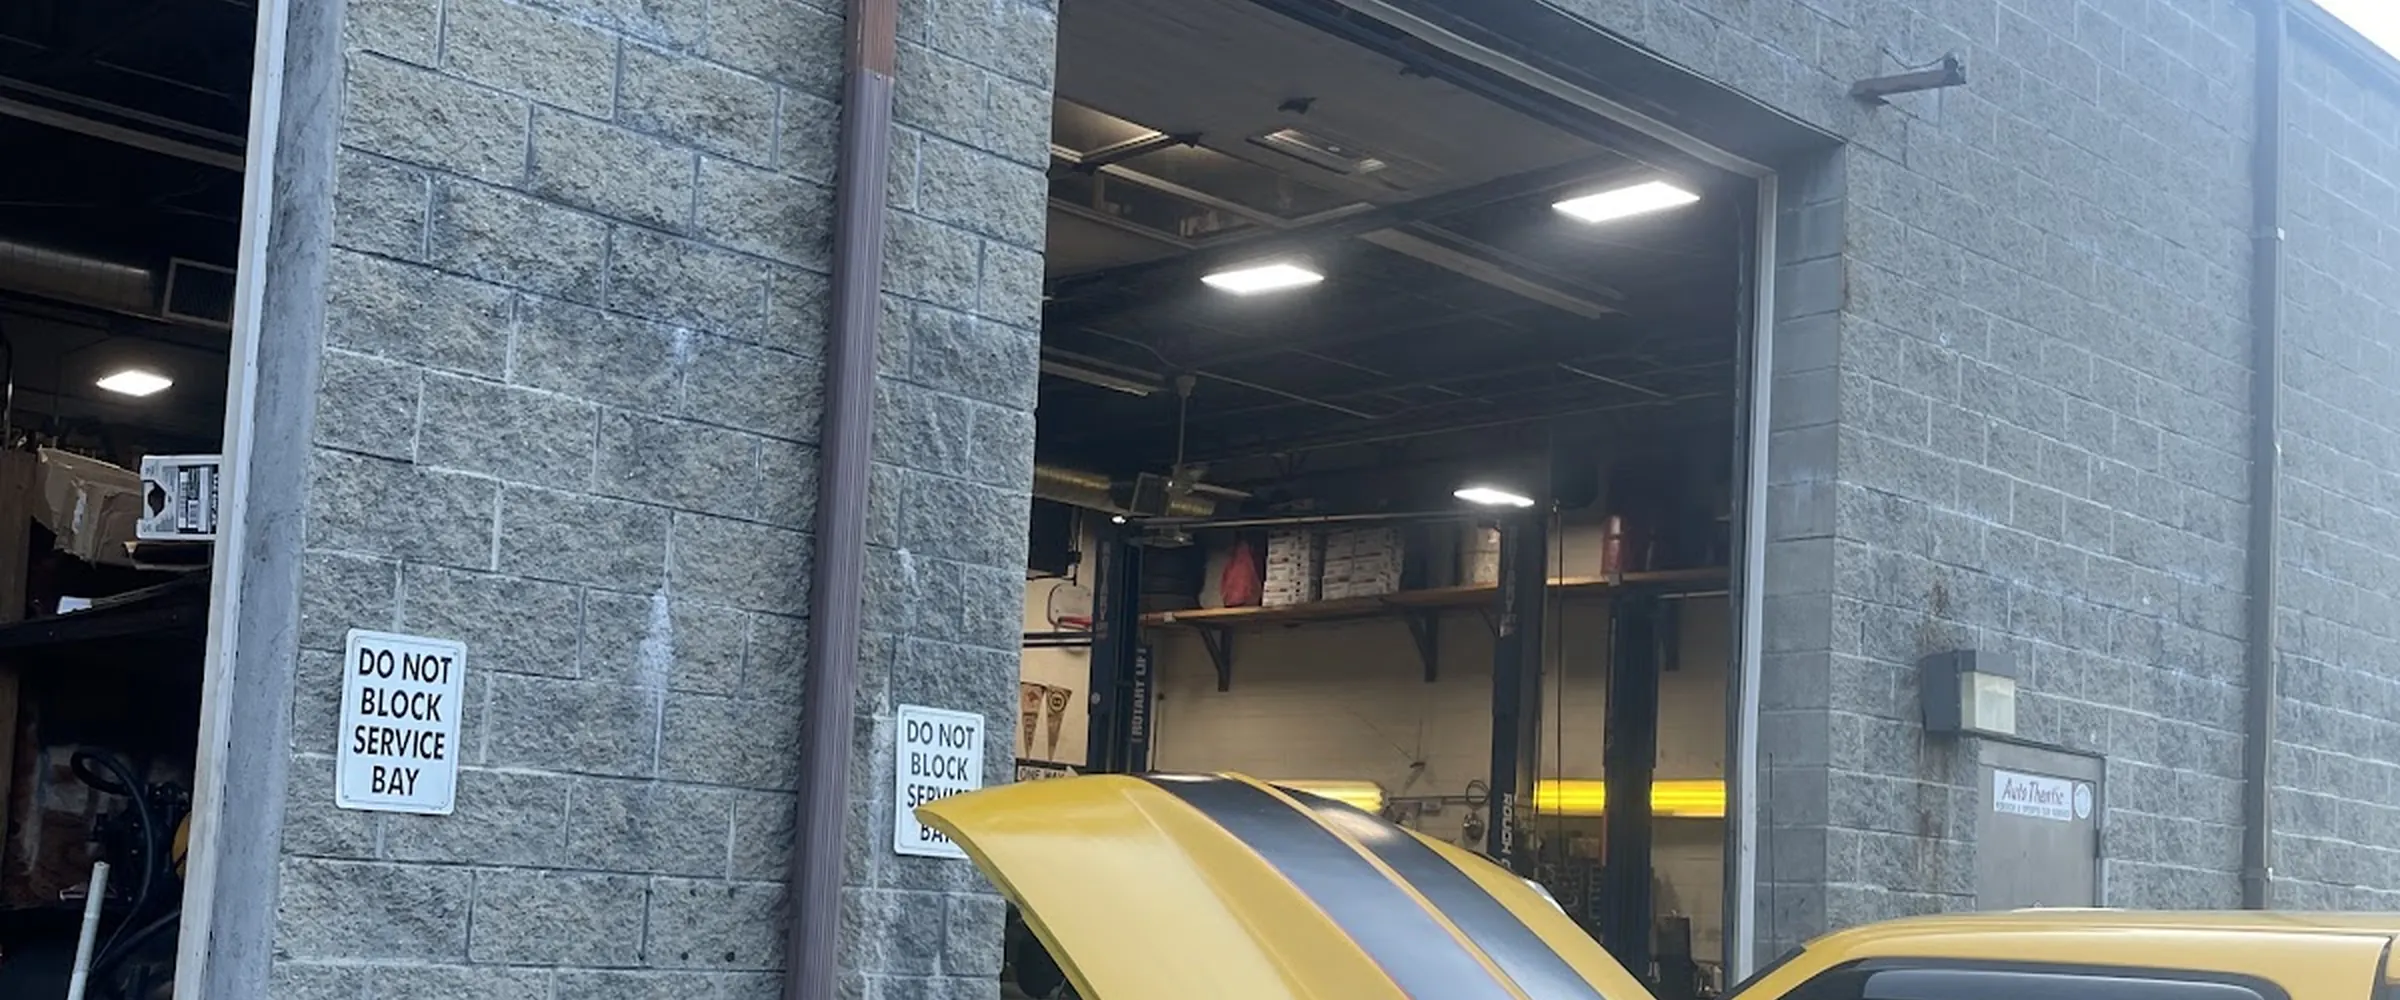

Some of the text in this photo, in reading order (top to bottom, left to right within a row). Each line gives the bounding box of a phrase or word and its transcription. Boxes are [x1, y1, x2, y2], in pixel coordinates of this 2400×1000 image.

[359, 647, 452, 684] DO NOT
[361, 687, 442, 722] BLOCK
[1131, 682, 1145, 737] ROTARY
[353, 725, 446, 760] SERVICE
[907, 720, 974, 750] DO NOT
[372, 765, 420, 796] BAY
[911, 752, 969, 781] BLOCK
[1019, 767, 1041, 780] ONE
[1501, 792, 1513, 855] ROUGH
